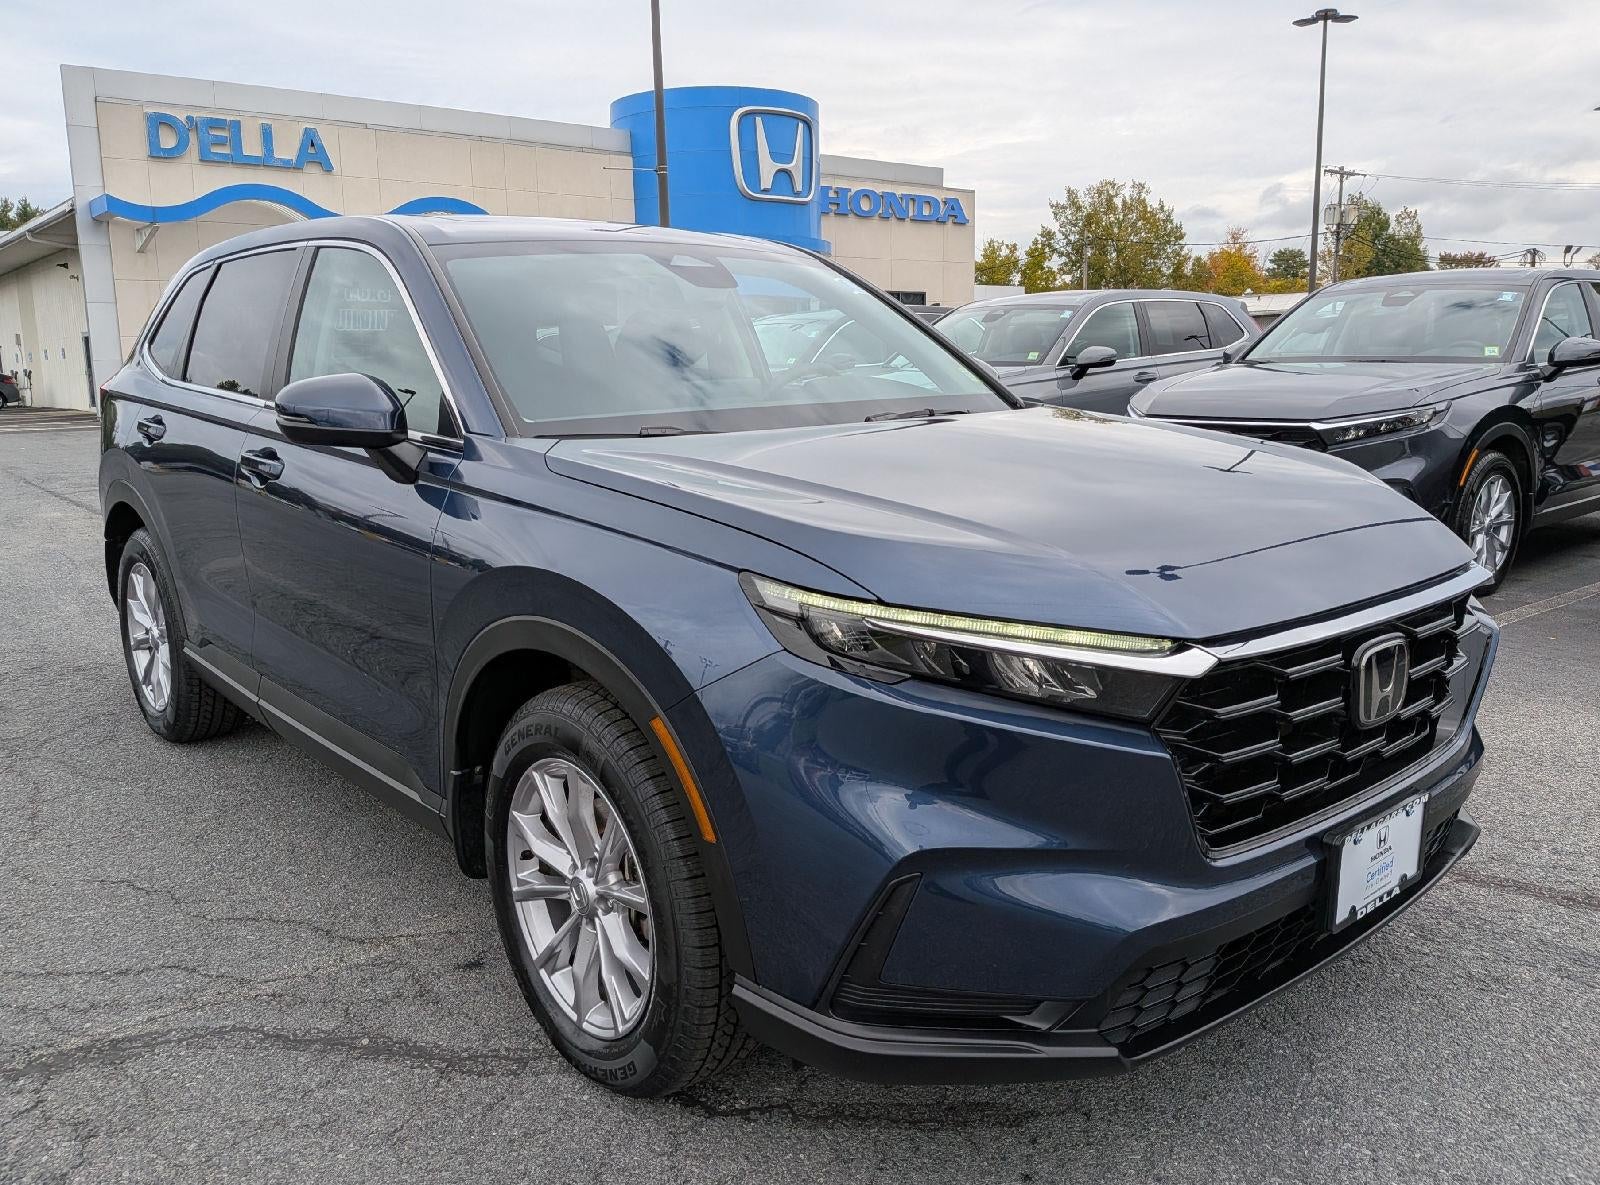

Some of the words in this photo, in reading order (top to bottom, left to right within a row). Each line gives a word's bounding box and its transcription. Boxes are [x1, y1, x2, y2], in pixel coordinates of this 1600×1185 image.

[145, 111, 335, 172] D'ELLA
[820, 185, 970, 224] HONDA
[1366, 856, 1395, 884] Certified
[1356, 886, 1401, 919] DELLA
